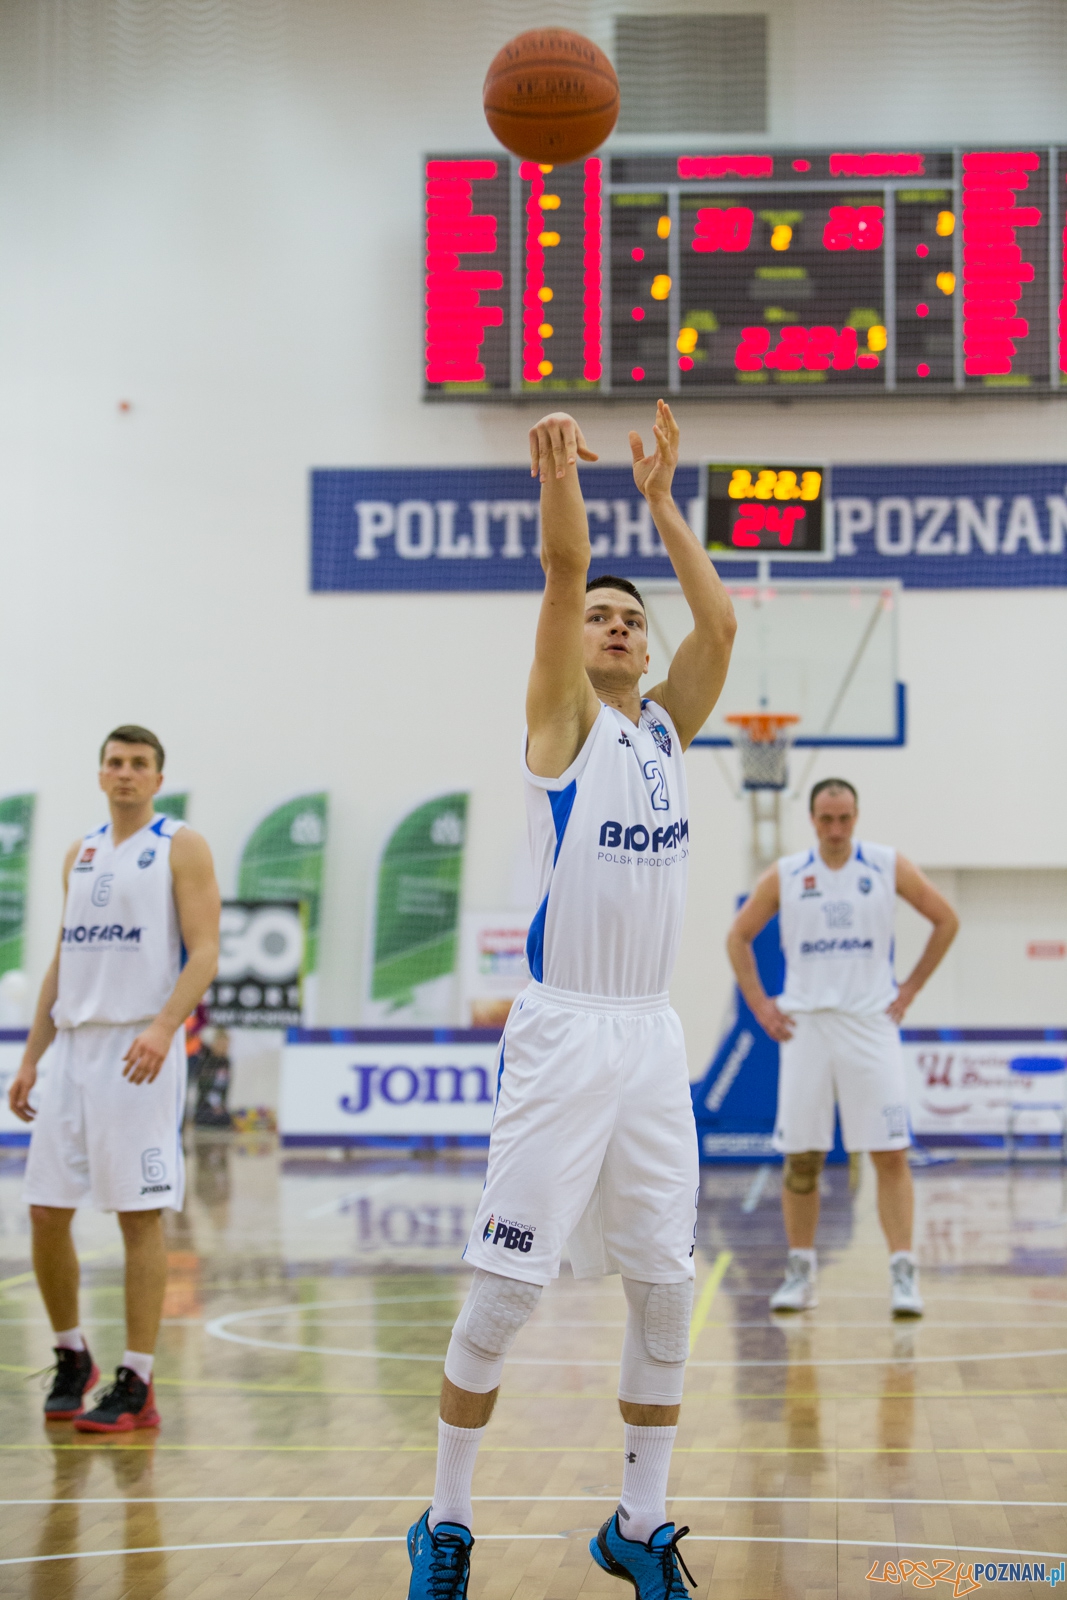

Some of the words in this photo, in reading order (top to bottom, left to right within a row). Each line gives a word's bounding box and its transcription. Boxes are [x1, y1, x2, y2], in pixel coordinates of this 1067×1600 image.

[692, 207, 754, 252] 30
[732, 503, 806, 547] 24
[643, 760, 670, 811] 2
[91, 873, 115, 908] 6
[822, 901, 854, 930] 12
[140, 1147, 167, 1183] 6
[492, 1222, 534, 1253] PBG
[498, 1216, 537, 1232] fundacja
